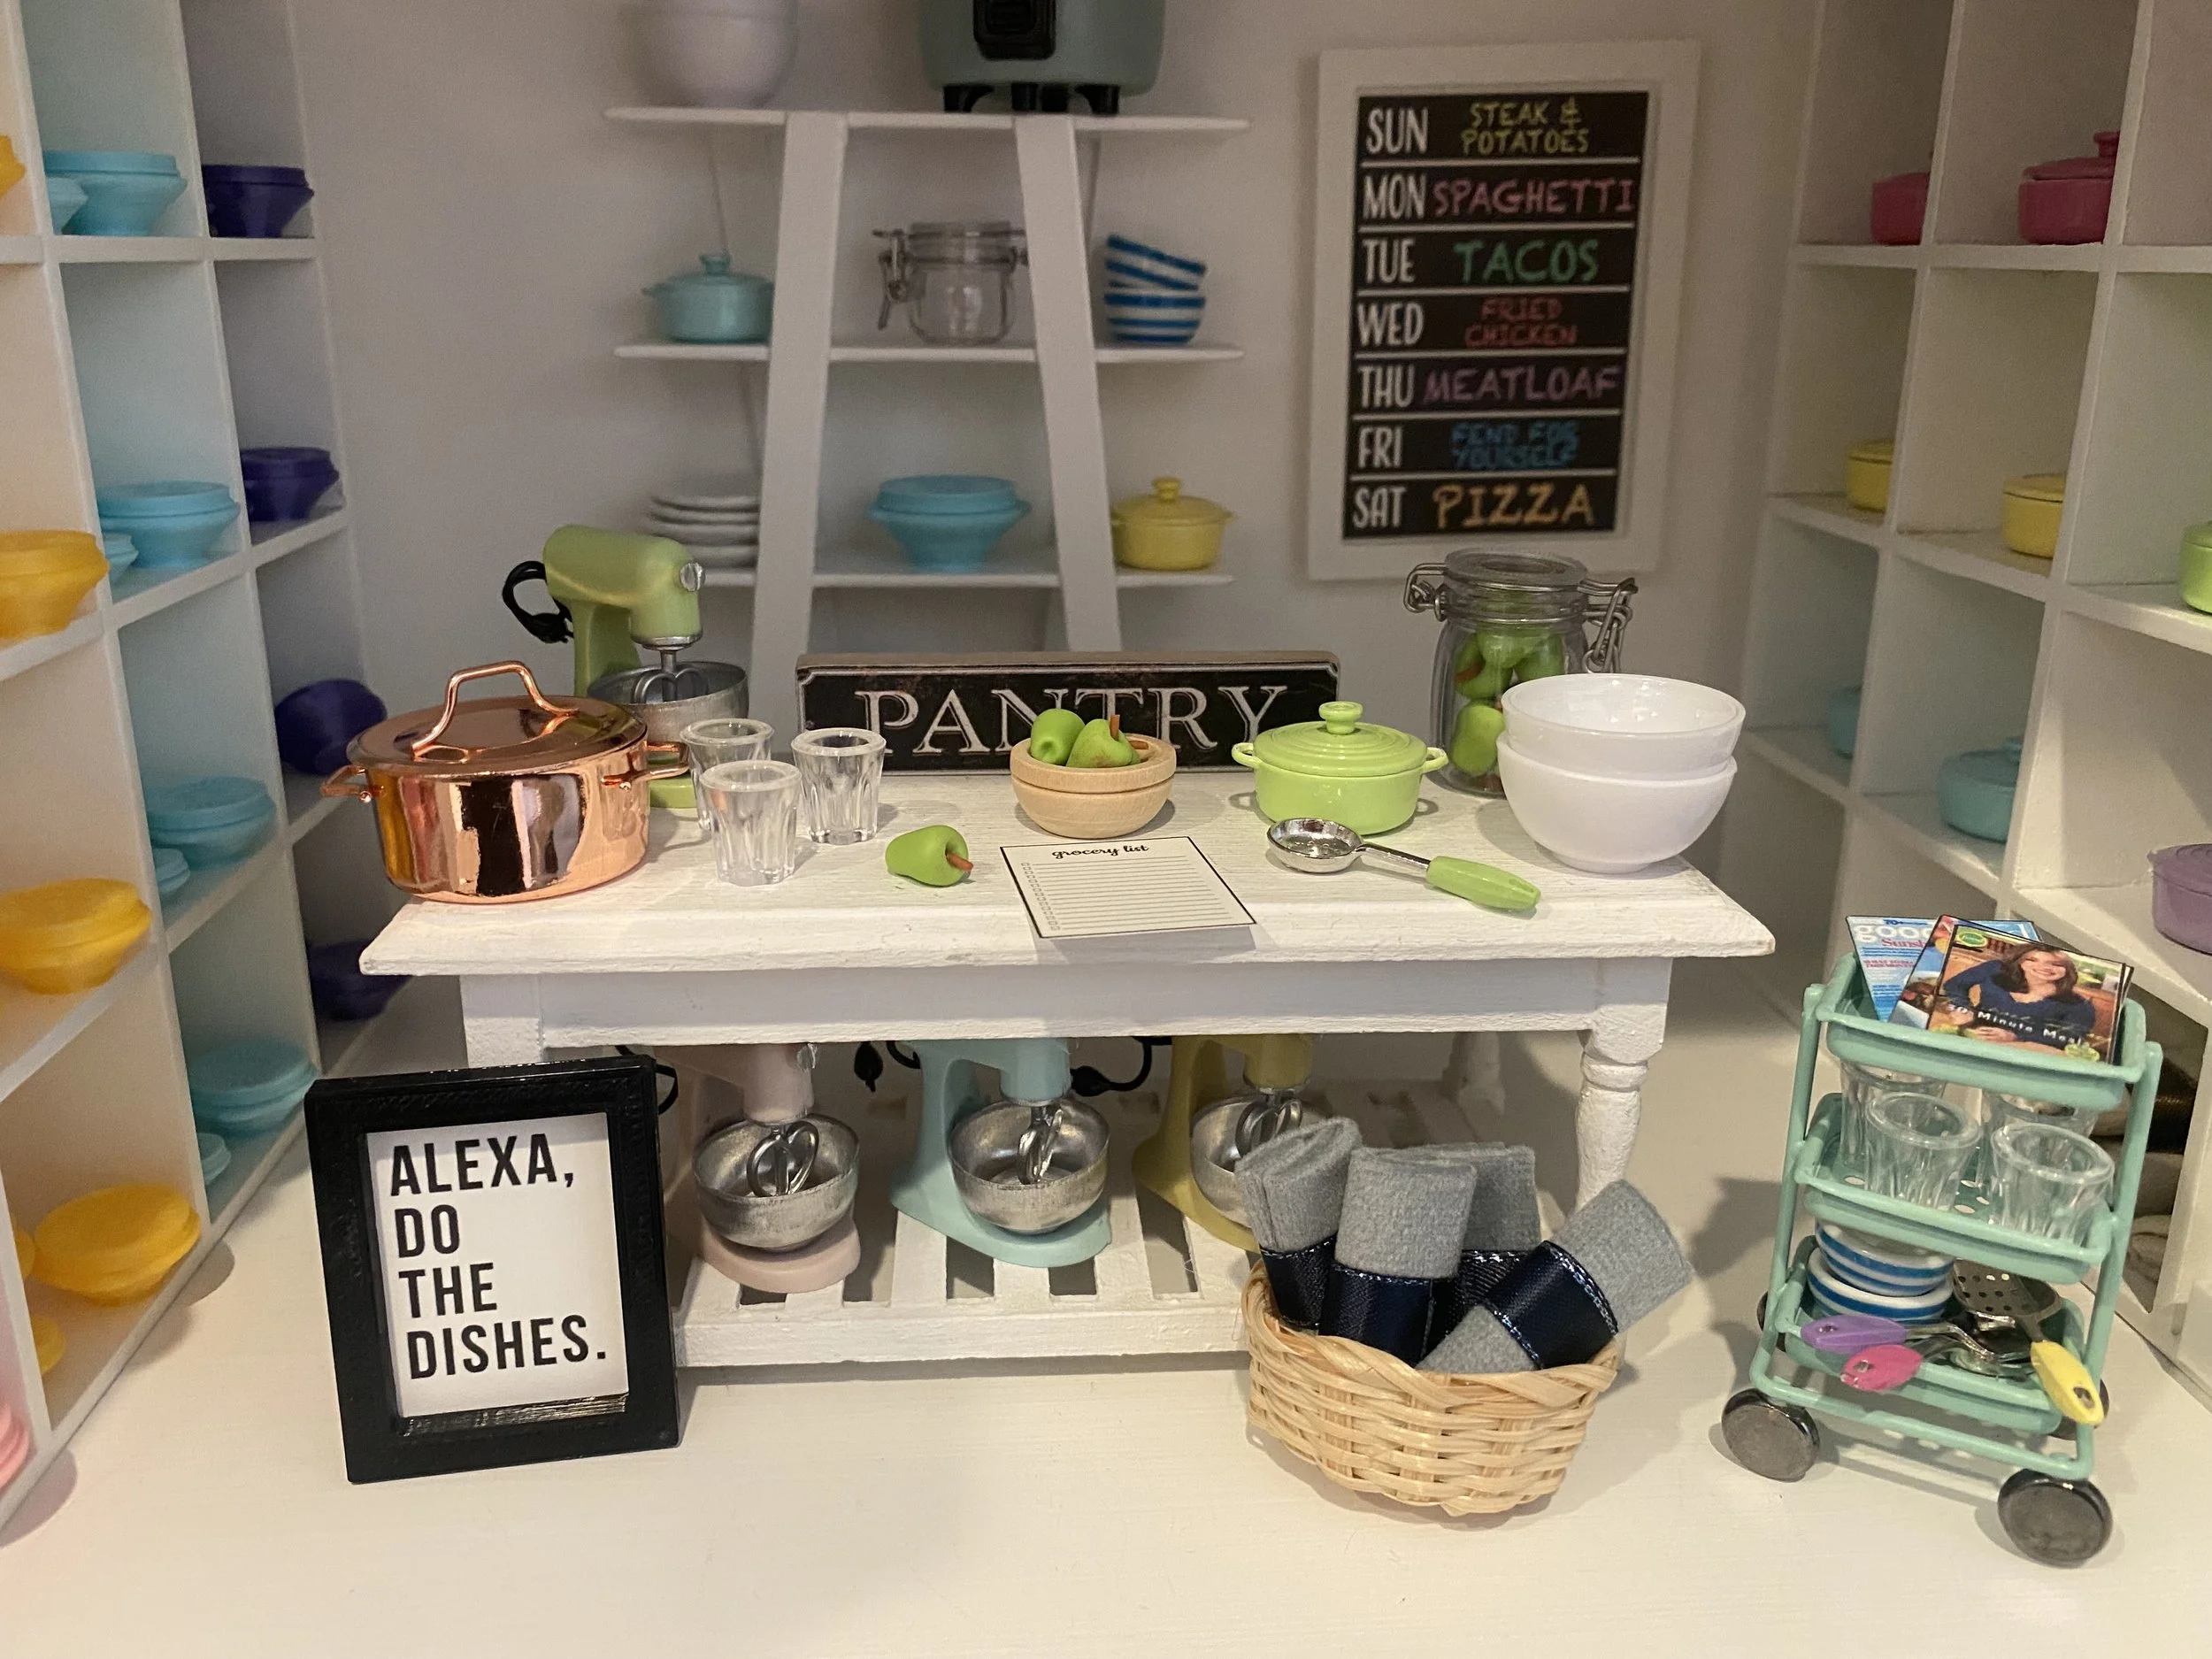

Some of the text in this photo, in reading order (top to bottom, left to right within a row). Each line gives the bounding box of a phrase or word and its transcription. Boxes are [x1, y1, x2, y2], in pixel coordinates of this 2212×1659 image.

[1366, 107, 1429, 155] SUN
[1470, 102, 1549, 128] STEAK
[1461, 127, 1590, 155] POTATOES
[1363, 174, 1427, 220] MON
[1432, 178, 1638, 218] SPAGHETTI
[1363, 237, 1416, 284] TUE
[1452, 238, 1600, 284] TACOS
[1356, 302, 1425, 347] WED
[1357, 364, 1416, 409] THU
[1423, 364, 1623, 404] MEATLOAF
[1358, 425, 1402, 469] FRI
[1353, 485, 1407, 529] SAT
[1432, 481, 1593, 530] PIZZA
[854, 686, 1288, 756] PANTRY
[1052, 844, 1150, 860] grocery list
[1978, 1010, 2034, 1033] Minute
[390, 1133, 575, 1197] ALEXA,
[395, 1204, 461, 1258] DO
[398, 1262, 498, 1318] THE
[406, 1314, 607, 1380] DISHES.
